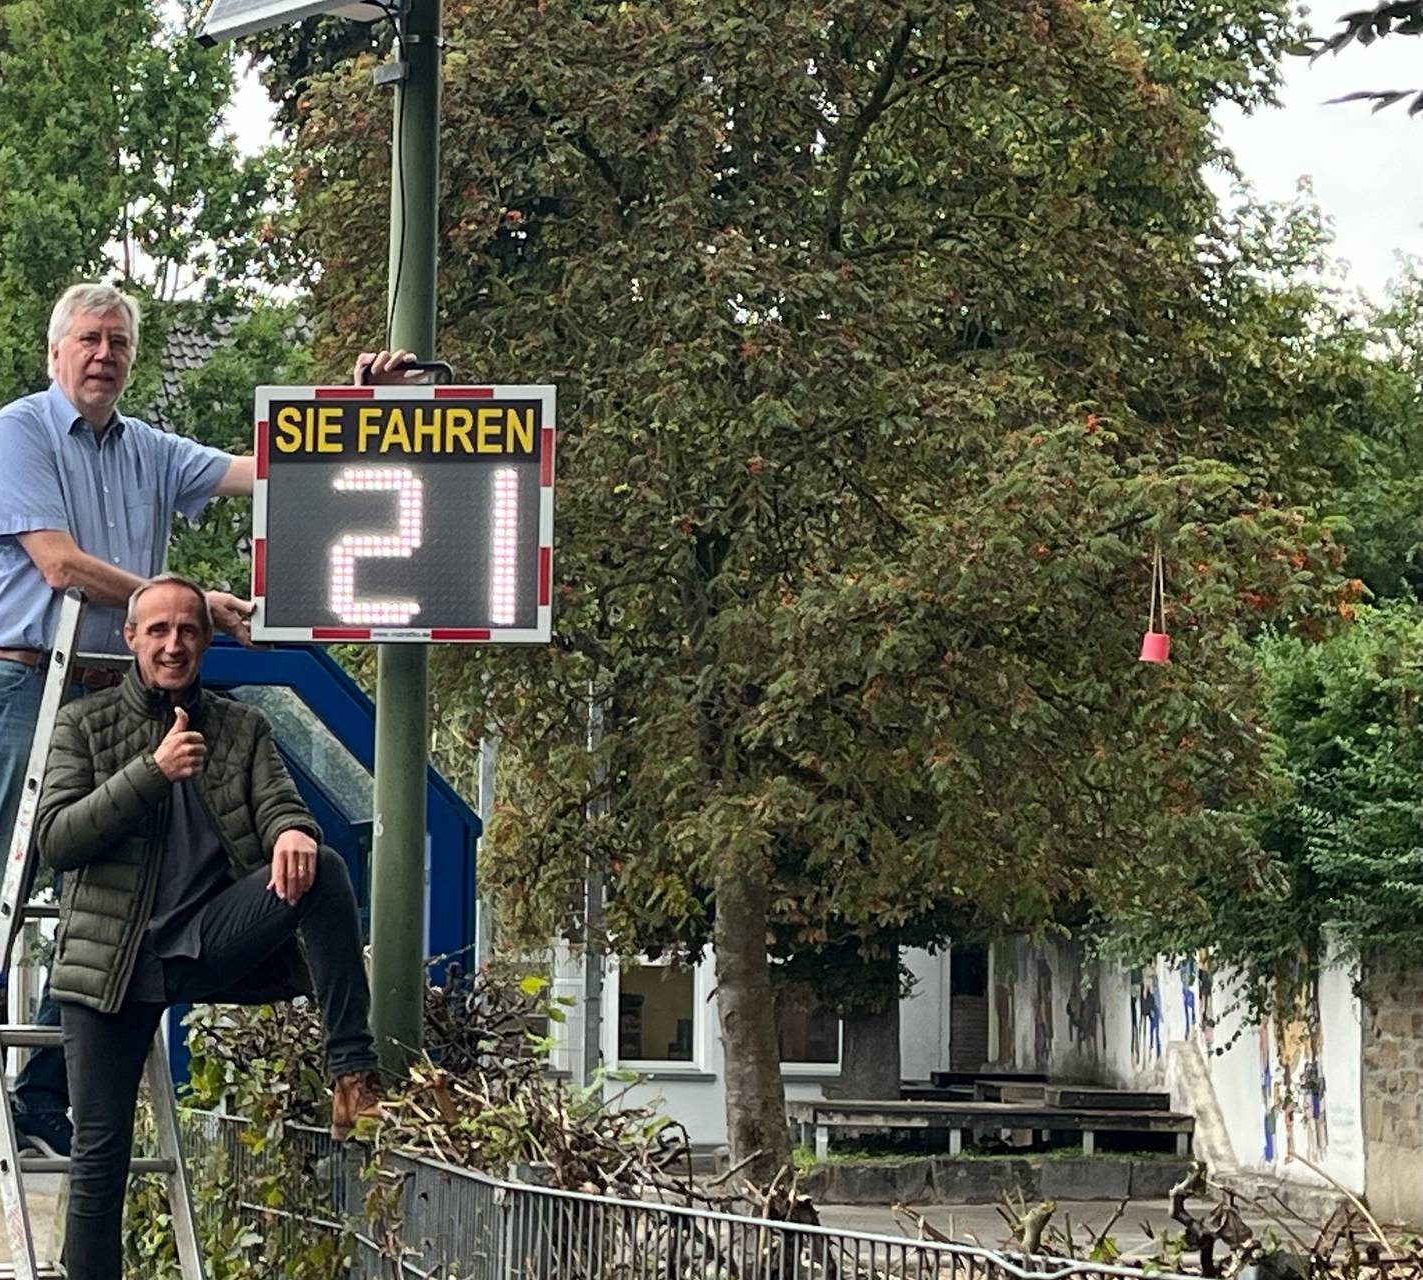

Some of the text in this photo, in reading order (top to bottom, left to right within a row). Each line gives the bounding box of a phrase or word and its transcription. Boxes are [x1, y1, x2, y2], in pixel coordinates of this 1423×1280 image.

[275, 406, 535, 454] SIE FAHREN
[331, 467, 519, 625] 21
